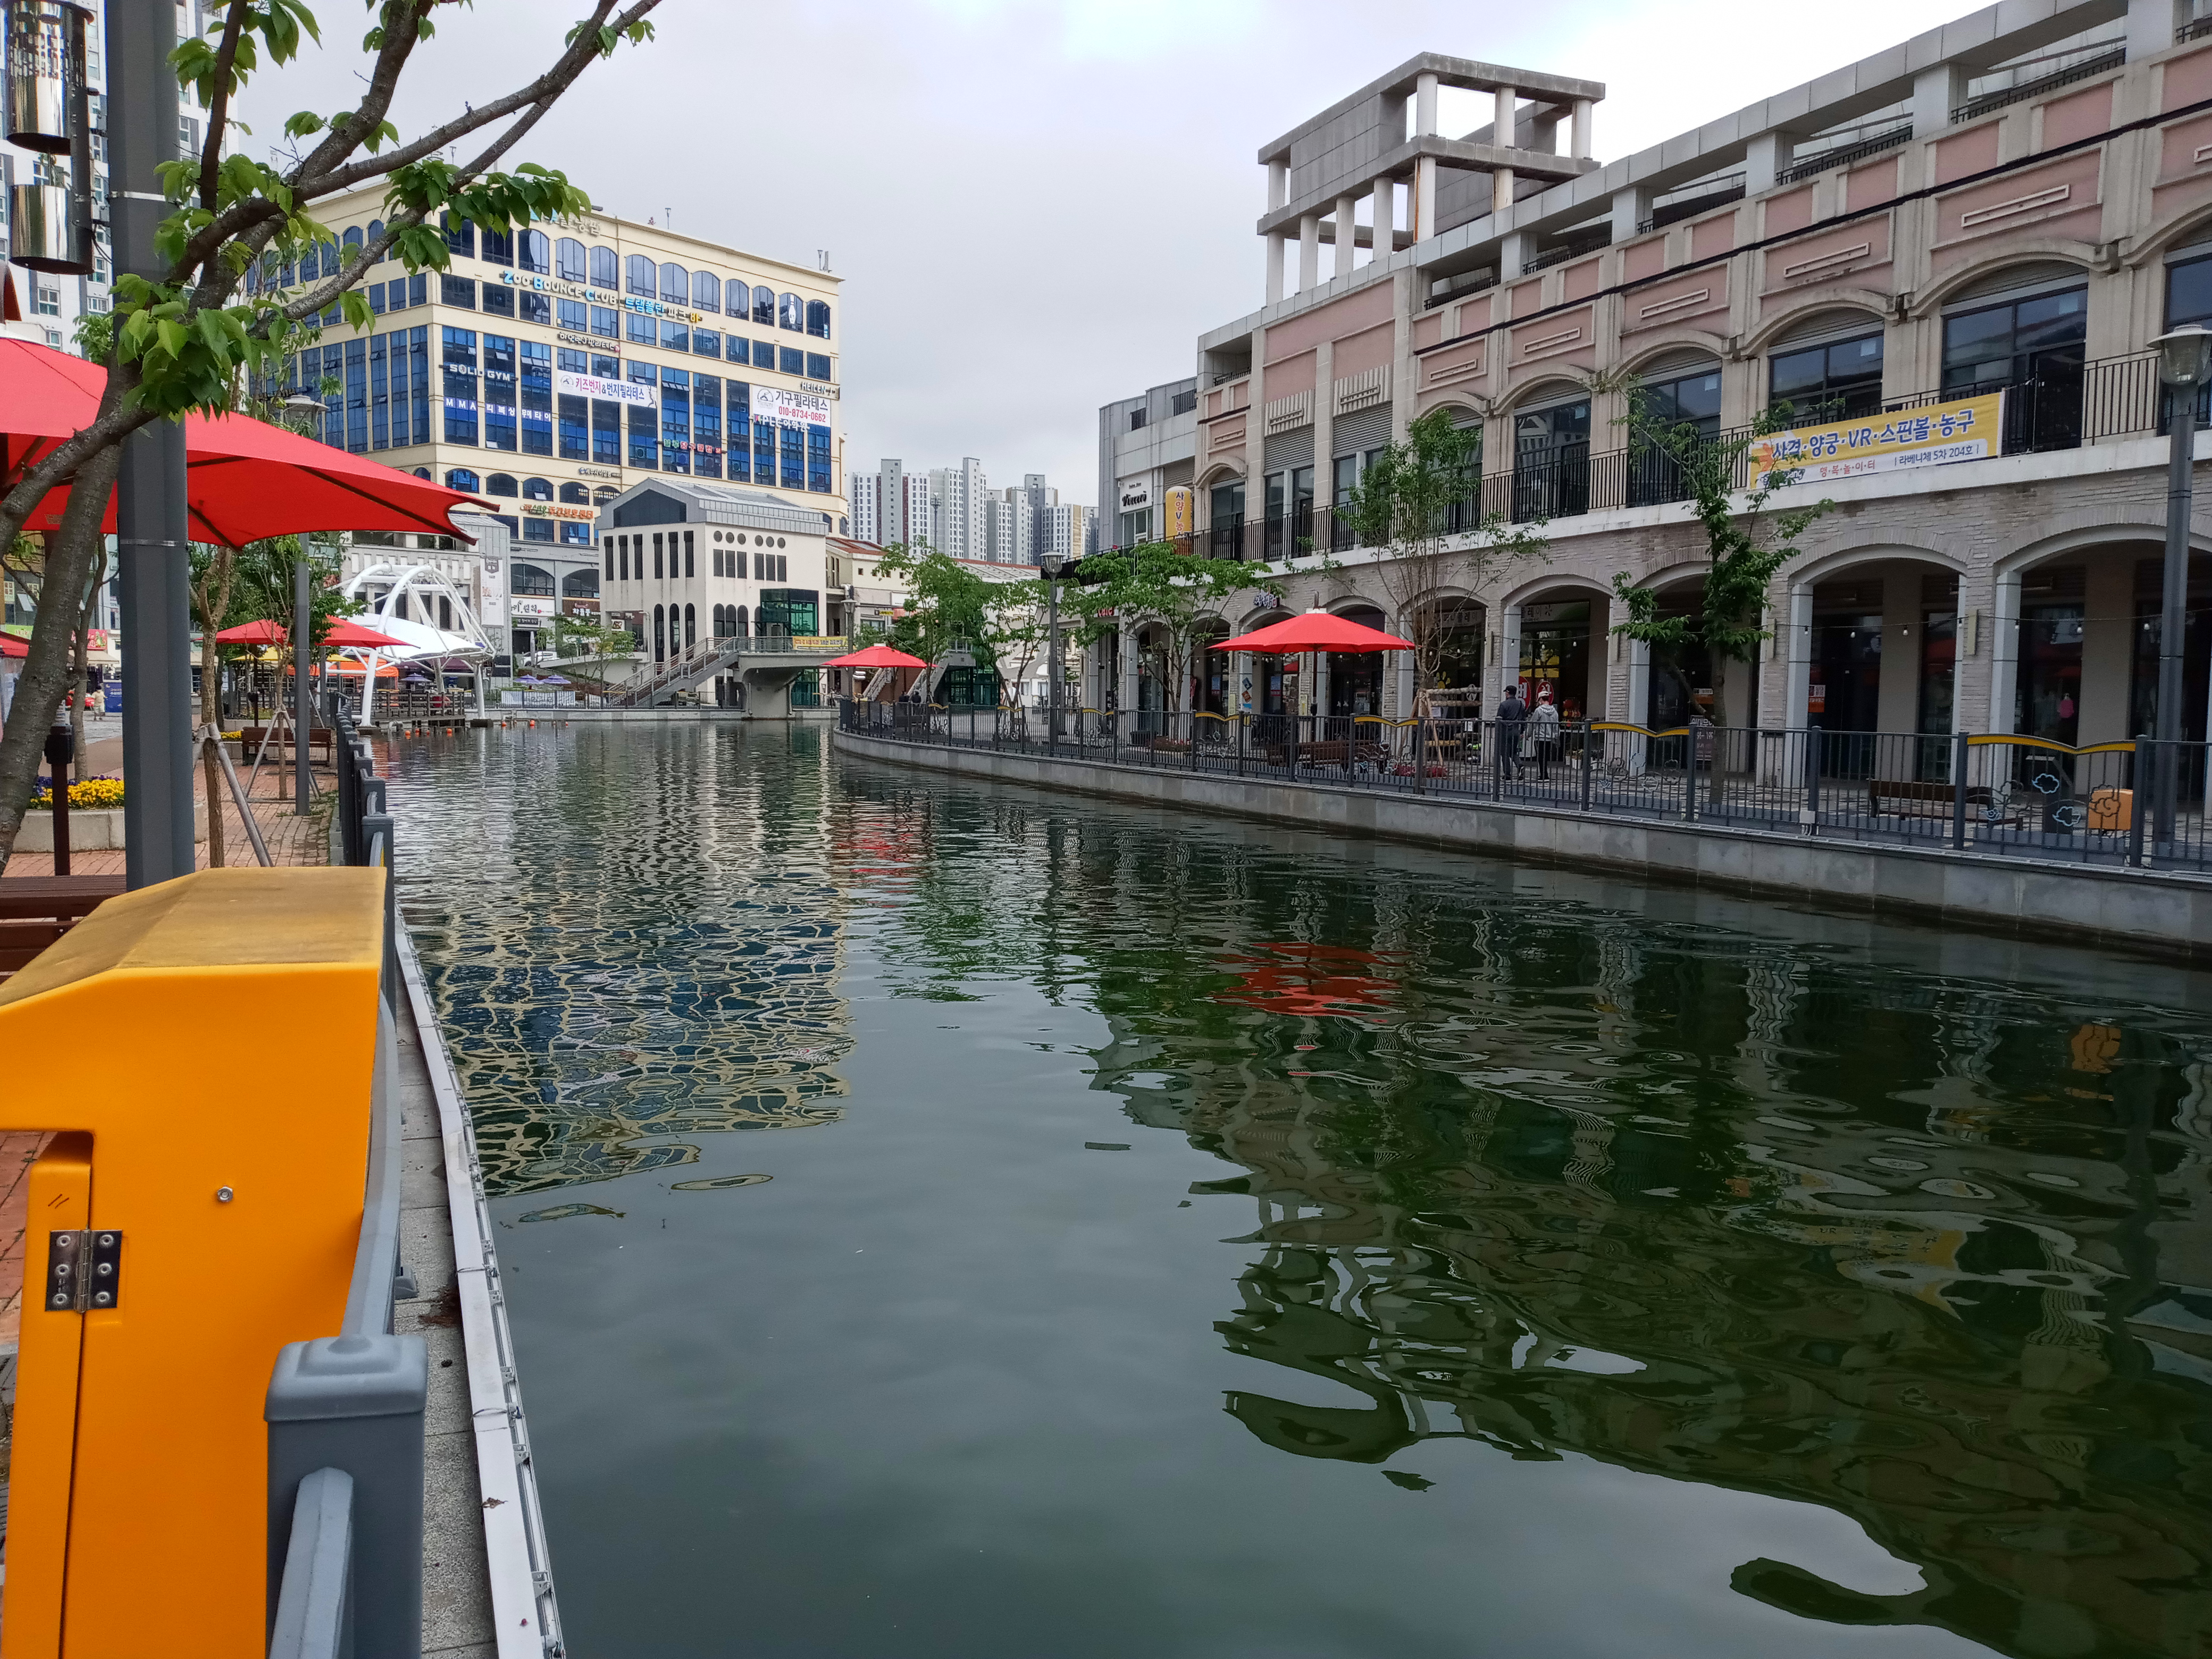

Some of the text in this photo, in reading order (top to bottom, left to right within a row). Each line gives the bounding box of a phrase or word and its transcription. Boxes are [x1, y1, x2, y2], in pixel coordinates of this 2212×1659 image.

[504, 270, 617, 305] ZOO BOUNCE CLUB
[625, 297, 664, 316] 트램폴린
[667, 306, 686, 321] 파크
[449, 364, 510, 381] SOLID GYM
[446, 398, 476, 410] MMA
[775, 390, 828, 410] 기구필라테스
[522, 409, 551, 422] 무에타이
[778, 406, 826, 423] 010-8734-0662
[1899, 445, 1973, 465] 라베니체 5차 204호
